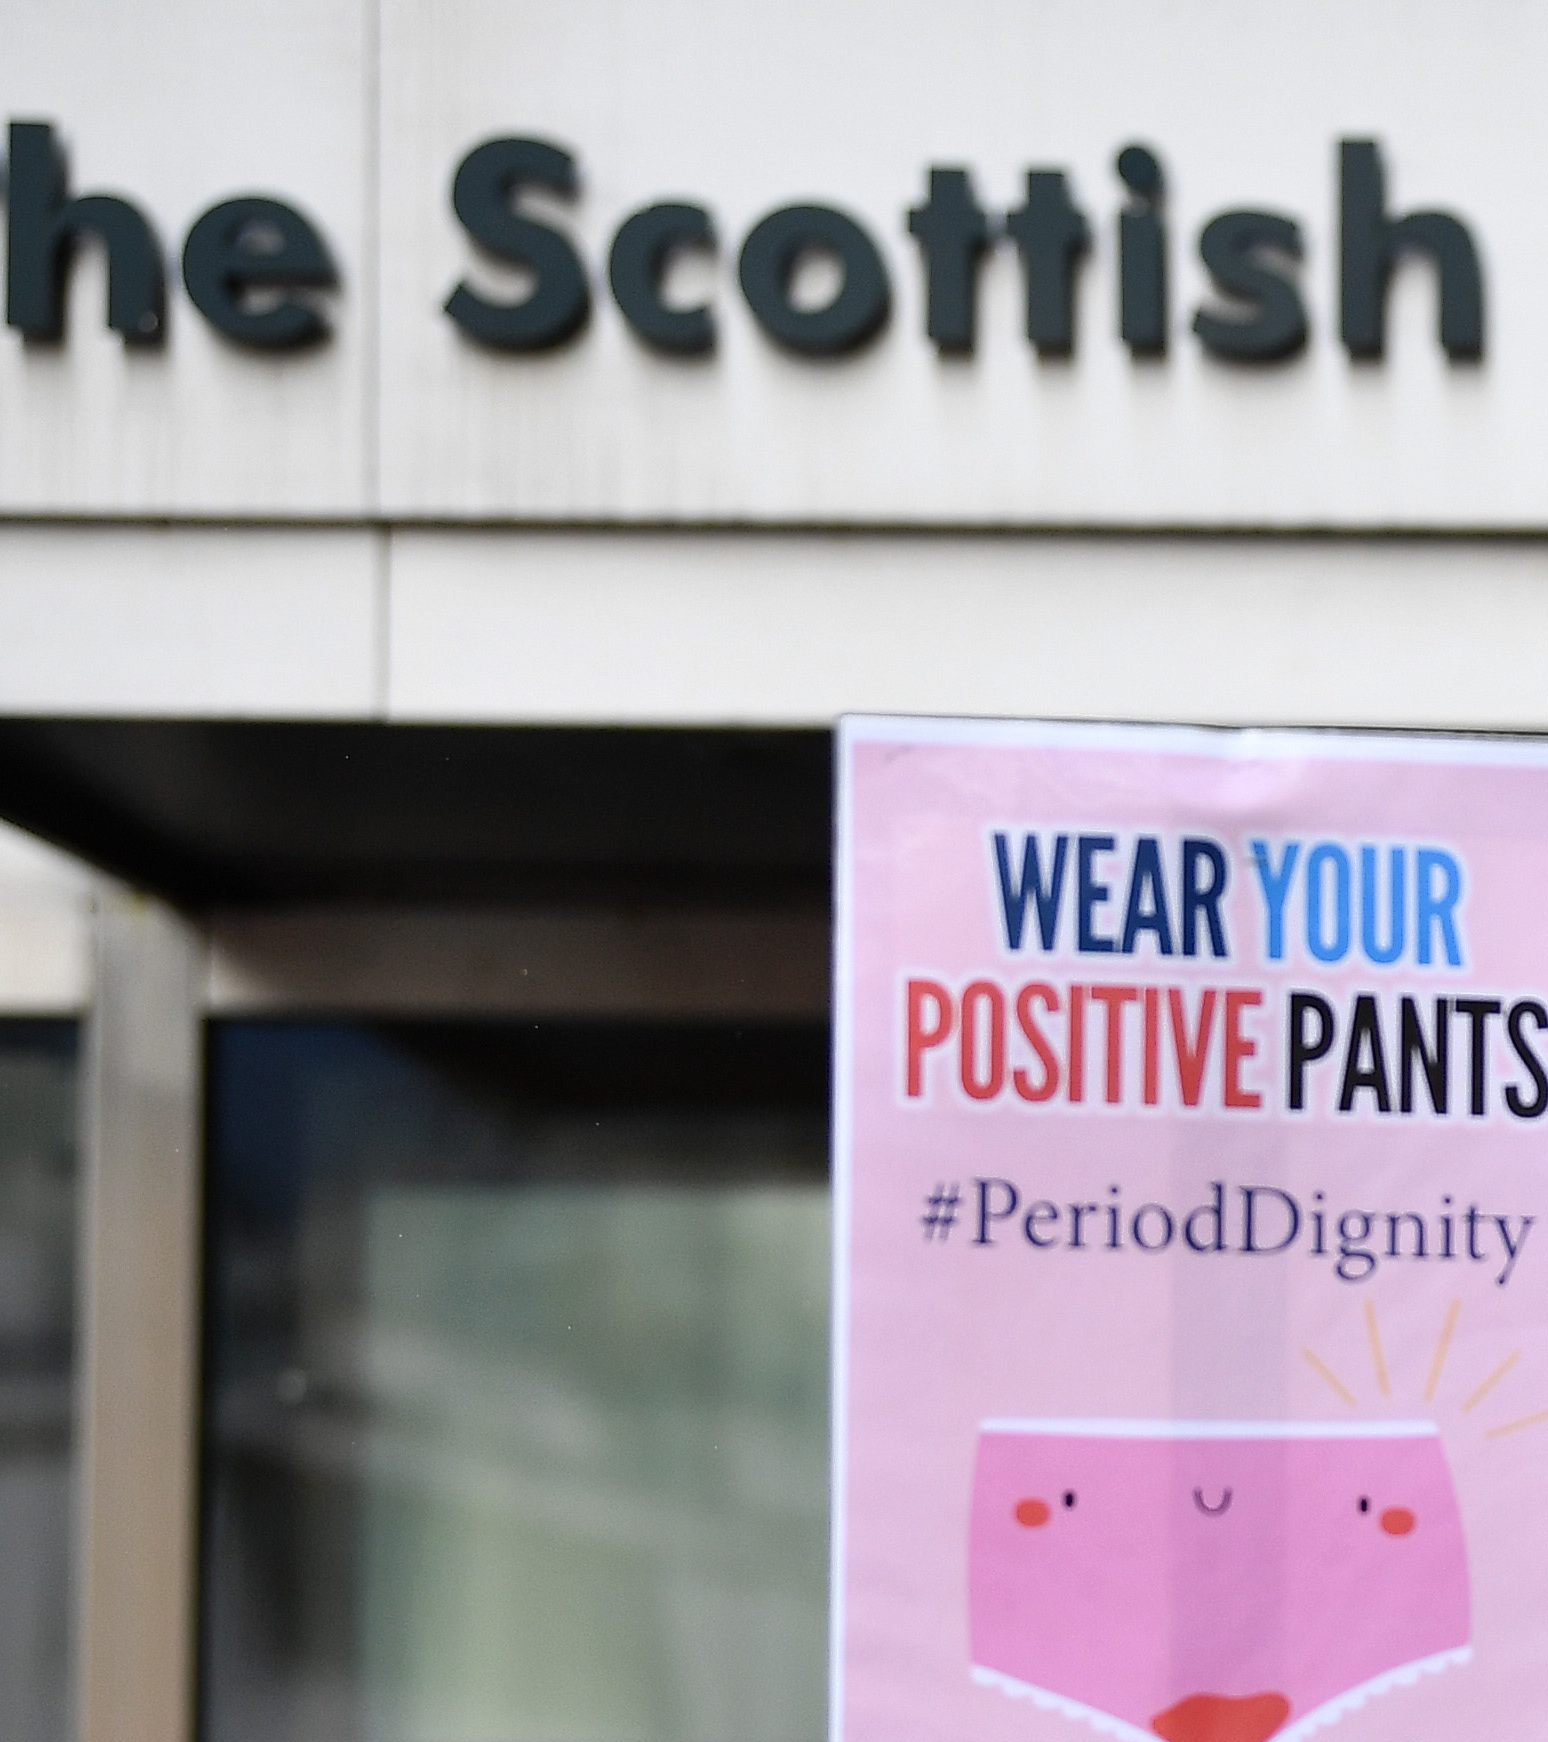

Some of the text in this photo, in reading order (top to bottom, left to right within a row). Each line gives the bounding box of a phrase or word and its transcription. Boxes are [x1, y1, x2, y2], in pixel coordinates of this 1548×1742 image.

[6, 118, 342, 352] he
[444, 134, 1490, 366] Scottish
[992, 832, 1466, 968] WEAR YOUR
[906, 979, 1263, 1110] POSITIVE
[921, 1176, 1538, 1288] #PeriodDignity
